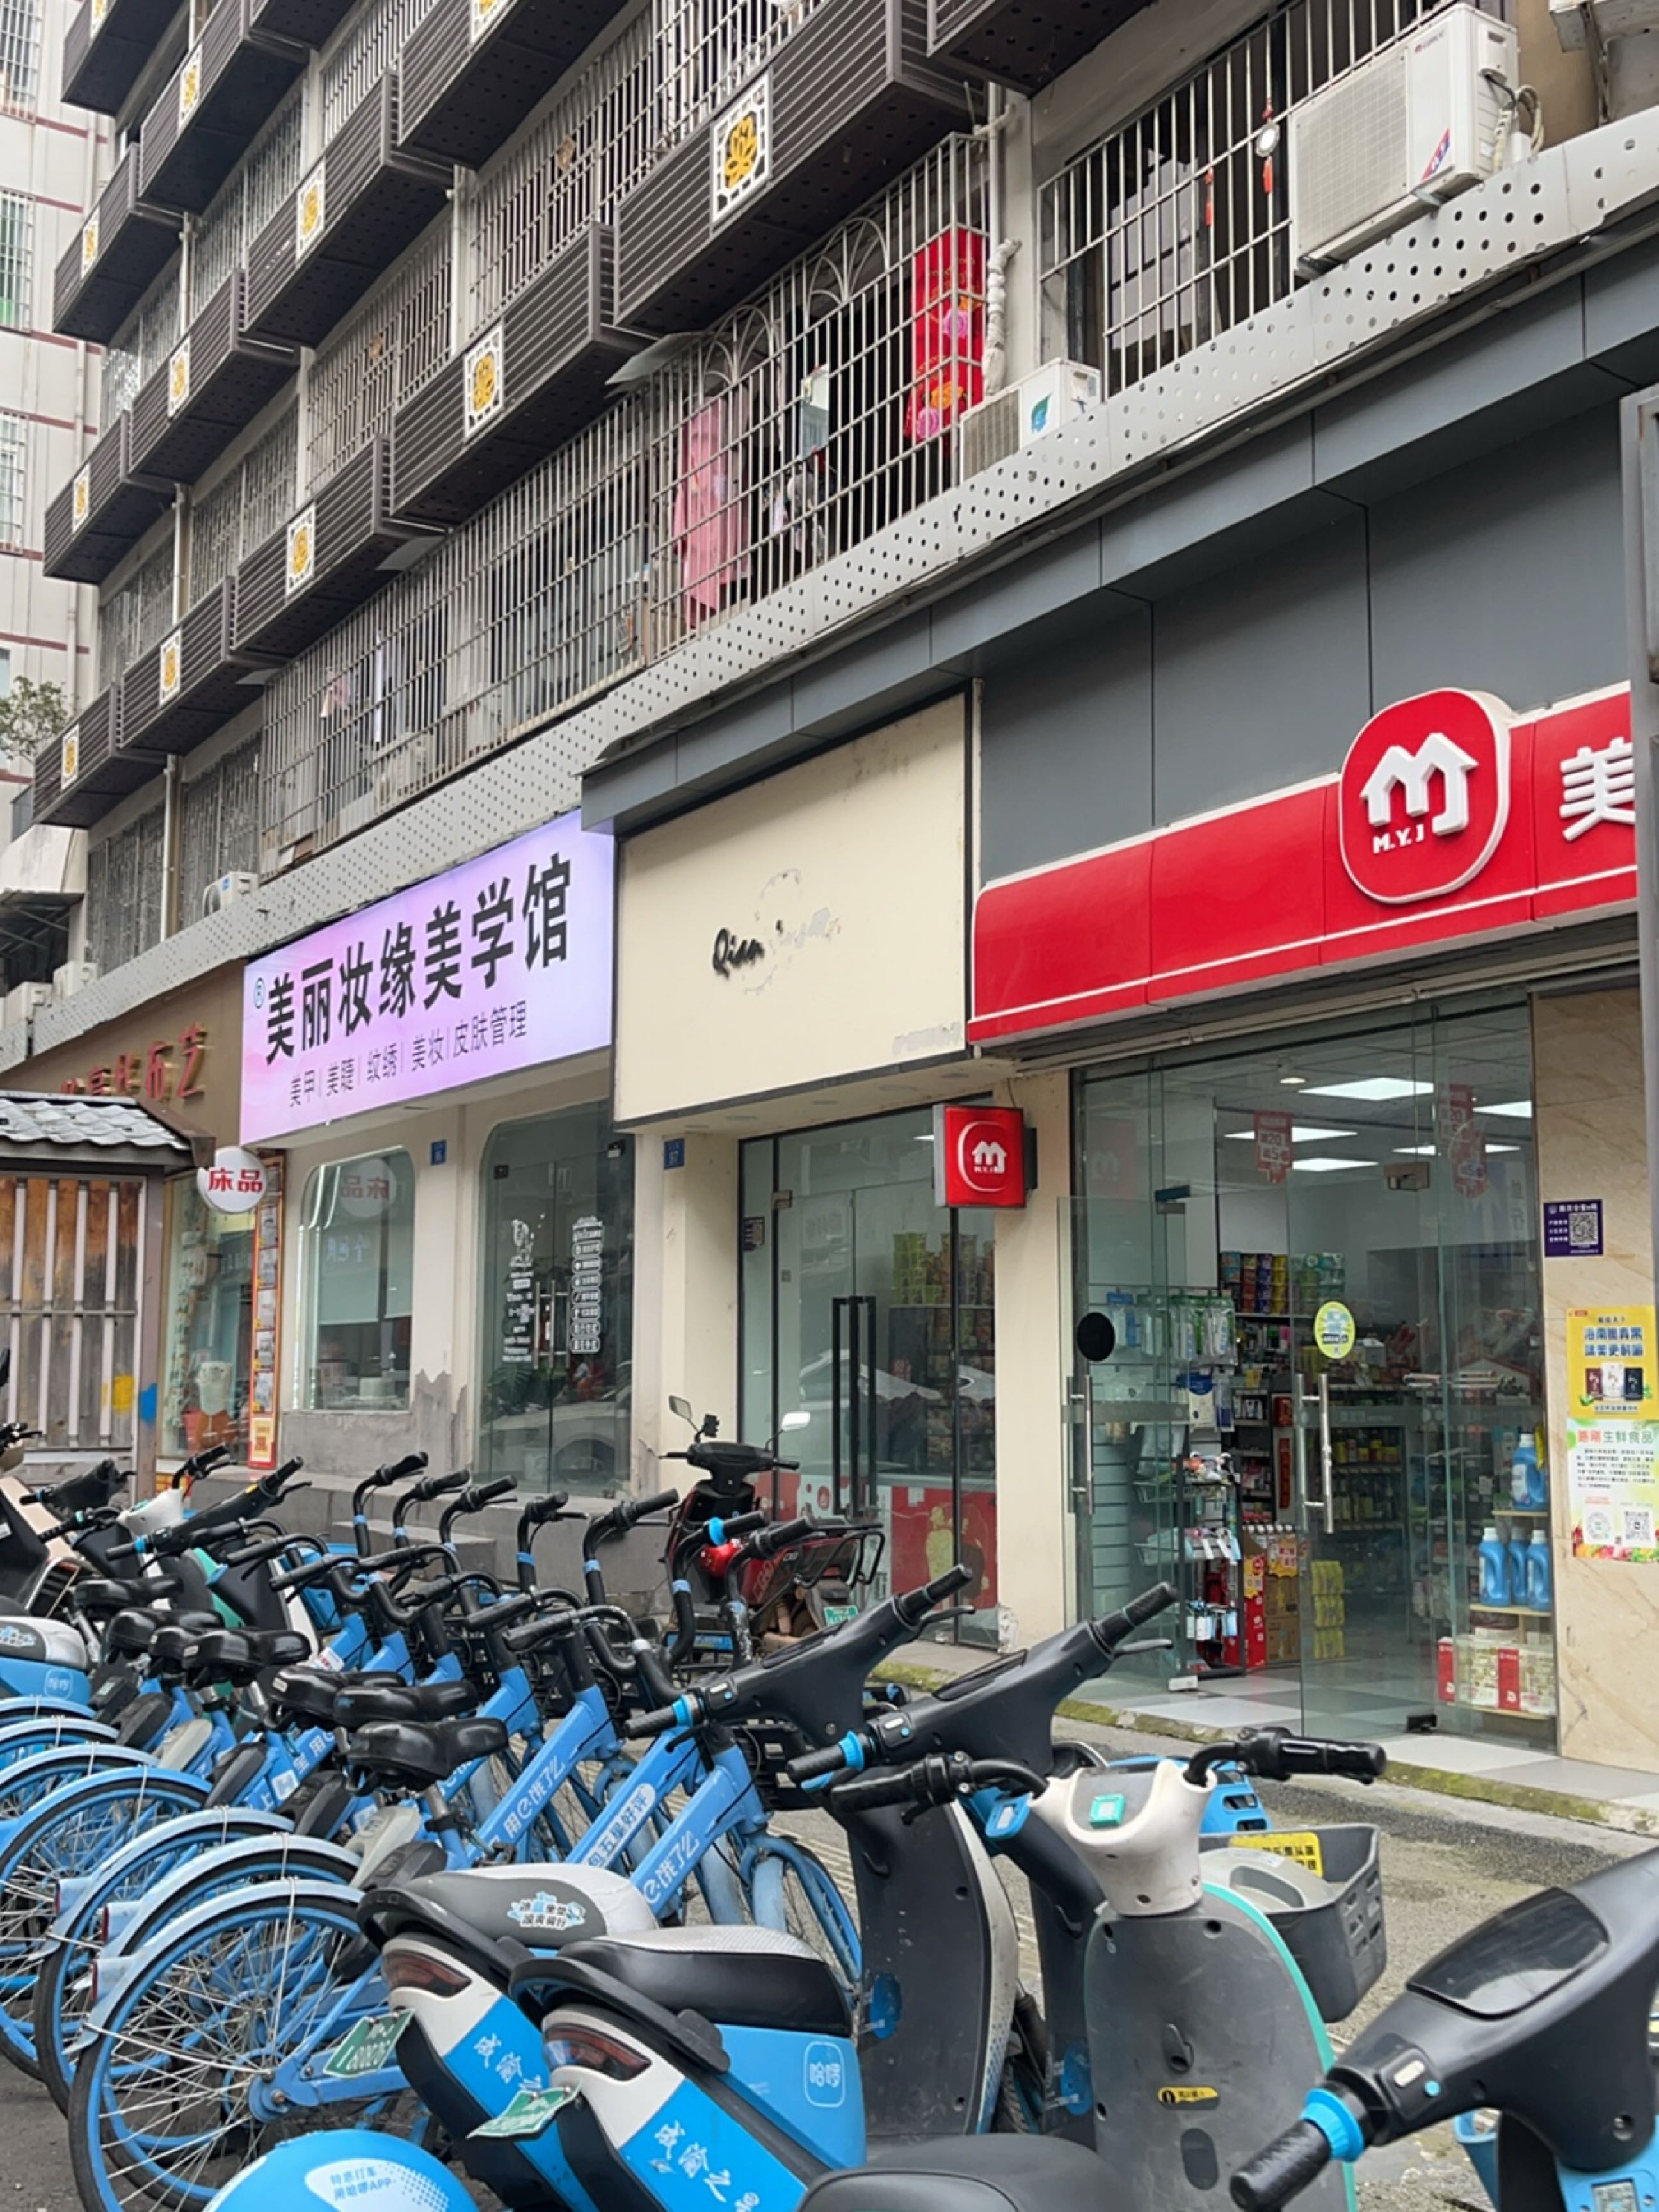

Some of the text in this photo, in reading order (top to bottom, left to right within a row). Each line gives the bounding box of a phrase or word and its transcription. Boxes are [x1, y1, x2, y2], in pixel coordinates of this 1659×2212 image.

[1559, 737, 1635, 841] 美
[266, 852, 571, 1065] 美丽妆缘美学馆
[208, 1167, 264, 1193] 床品
